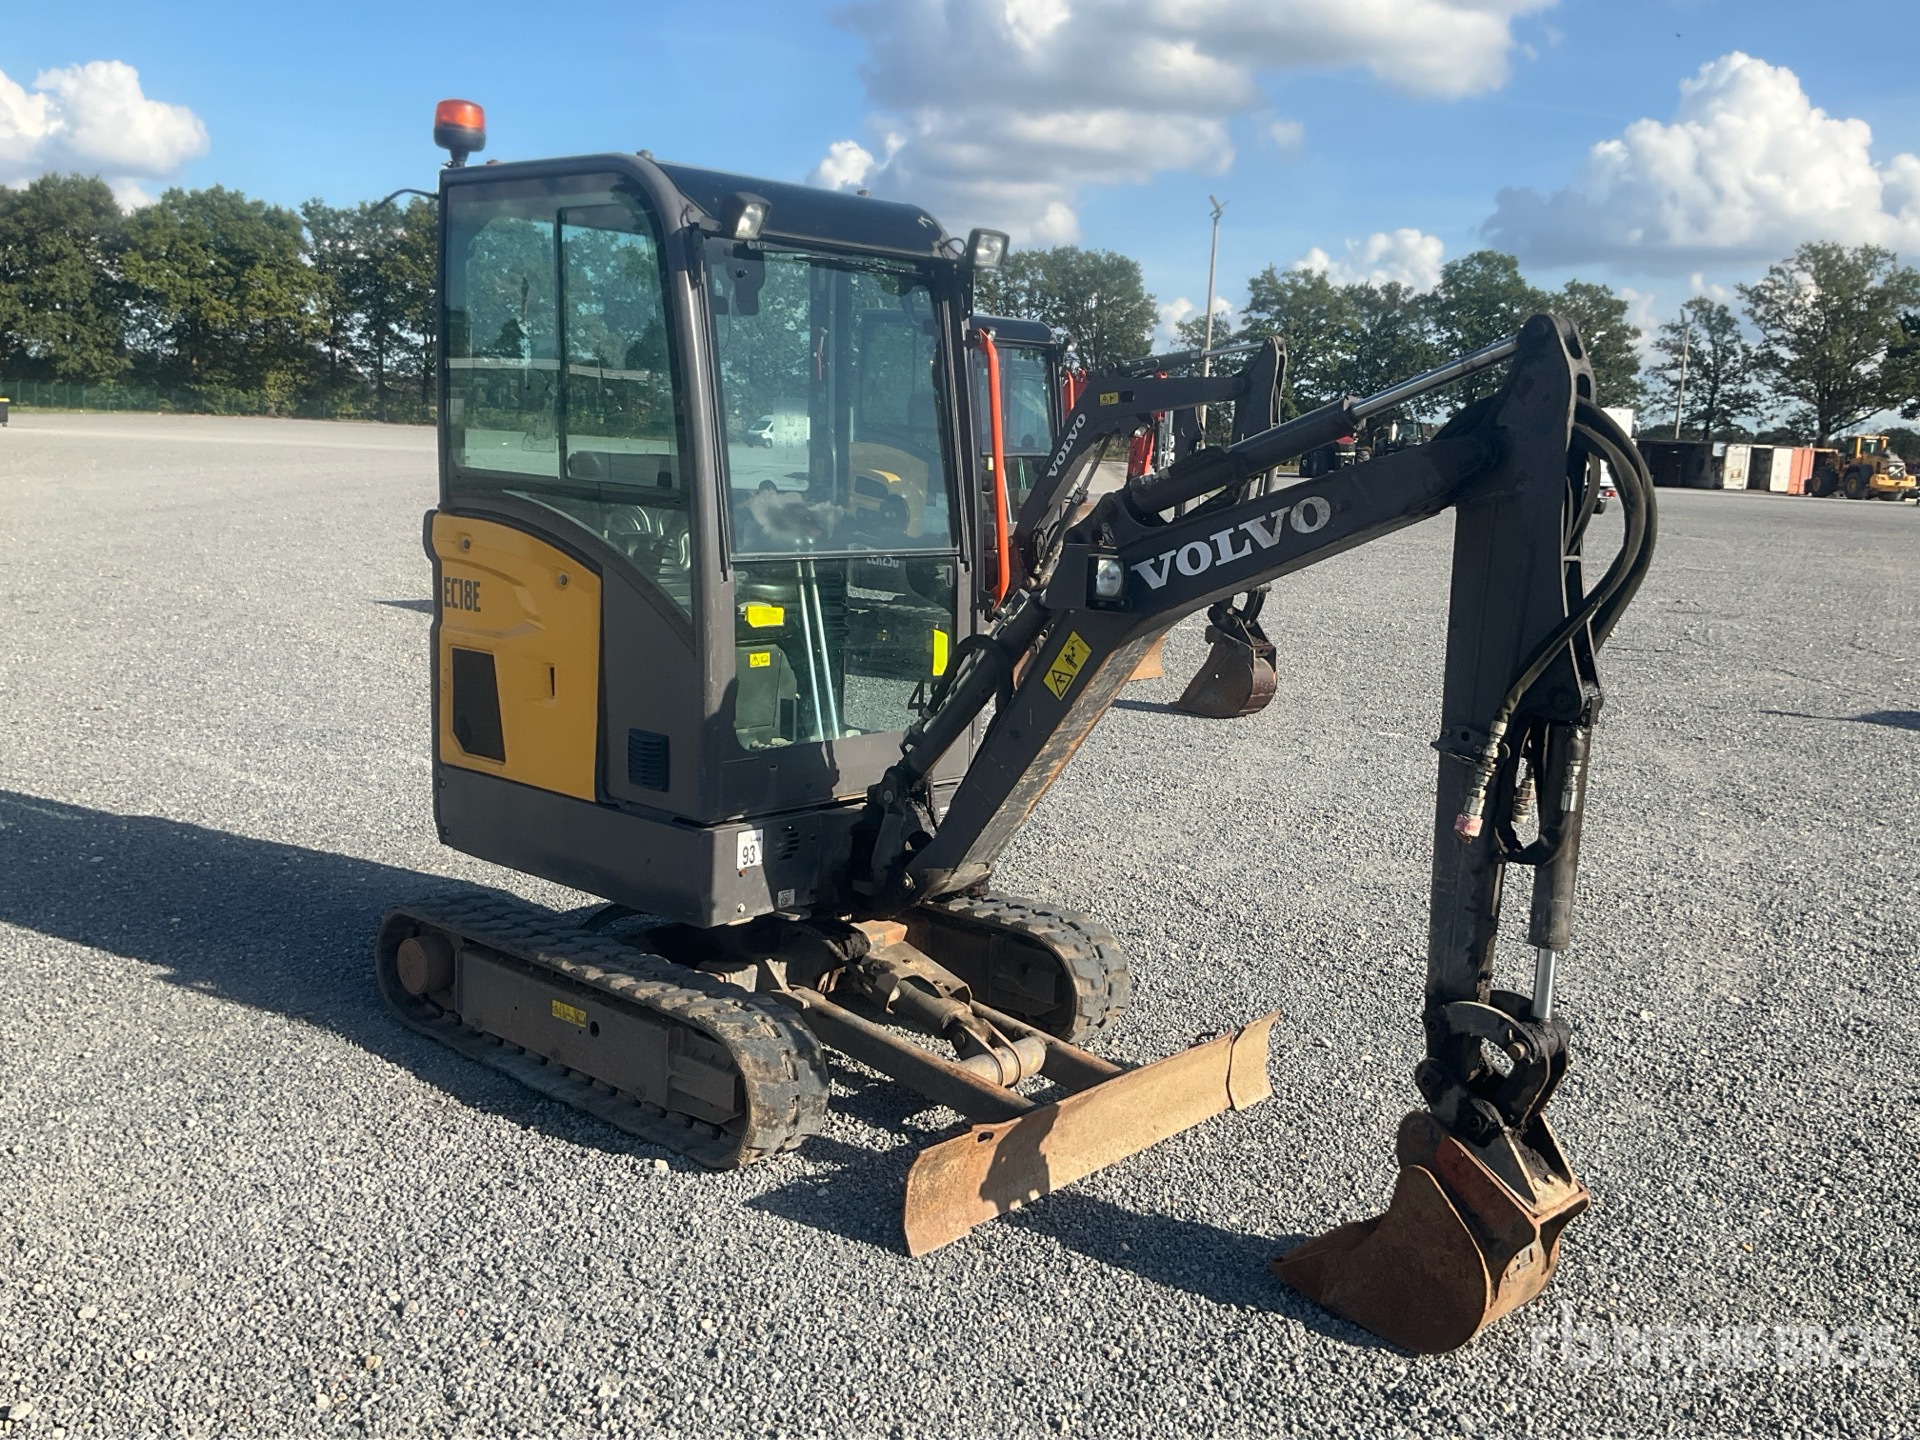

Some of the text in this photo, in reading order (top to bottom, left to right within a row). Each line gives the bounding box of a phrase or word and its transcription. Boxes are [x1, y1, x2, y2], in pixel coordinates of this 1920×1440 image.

[1047, 413, 1086, 477] VOLVO
[1130, 496, 1331, 590] VOLVO
[444, 576, 482, 612] EC18E
[742, 845, 756, 866] 93
